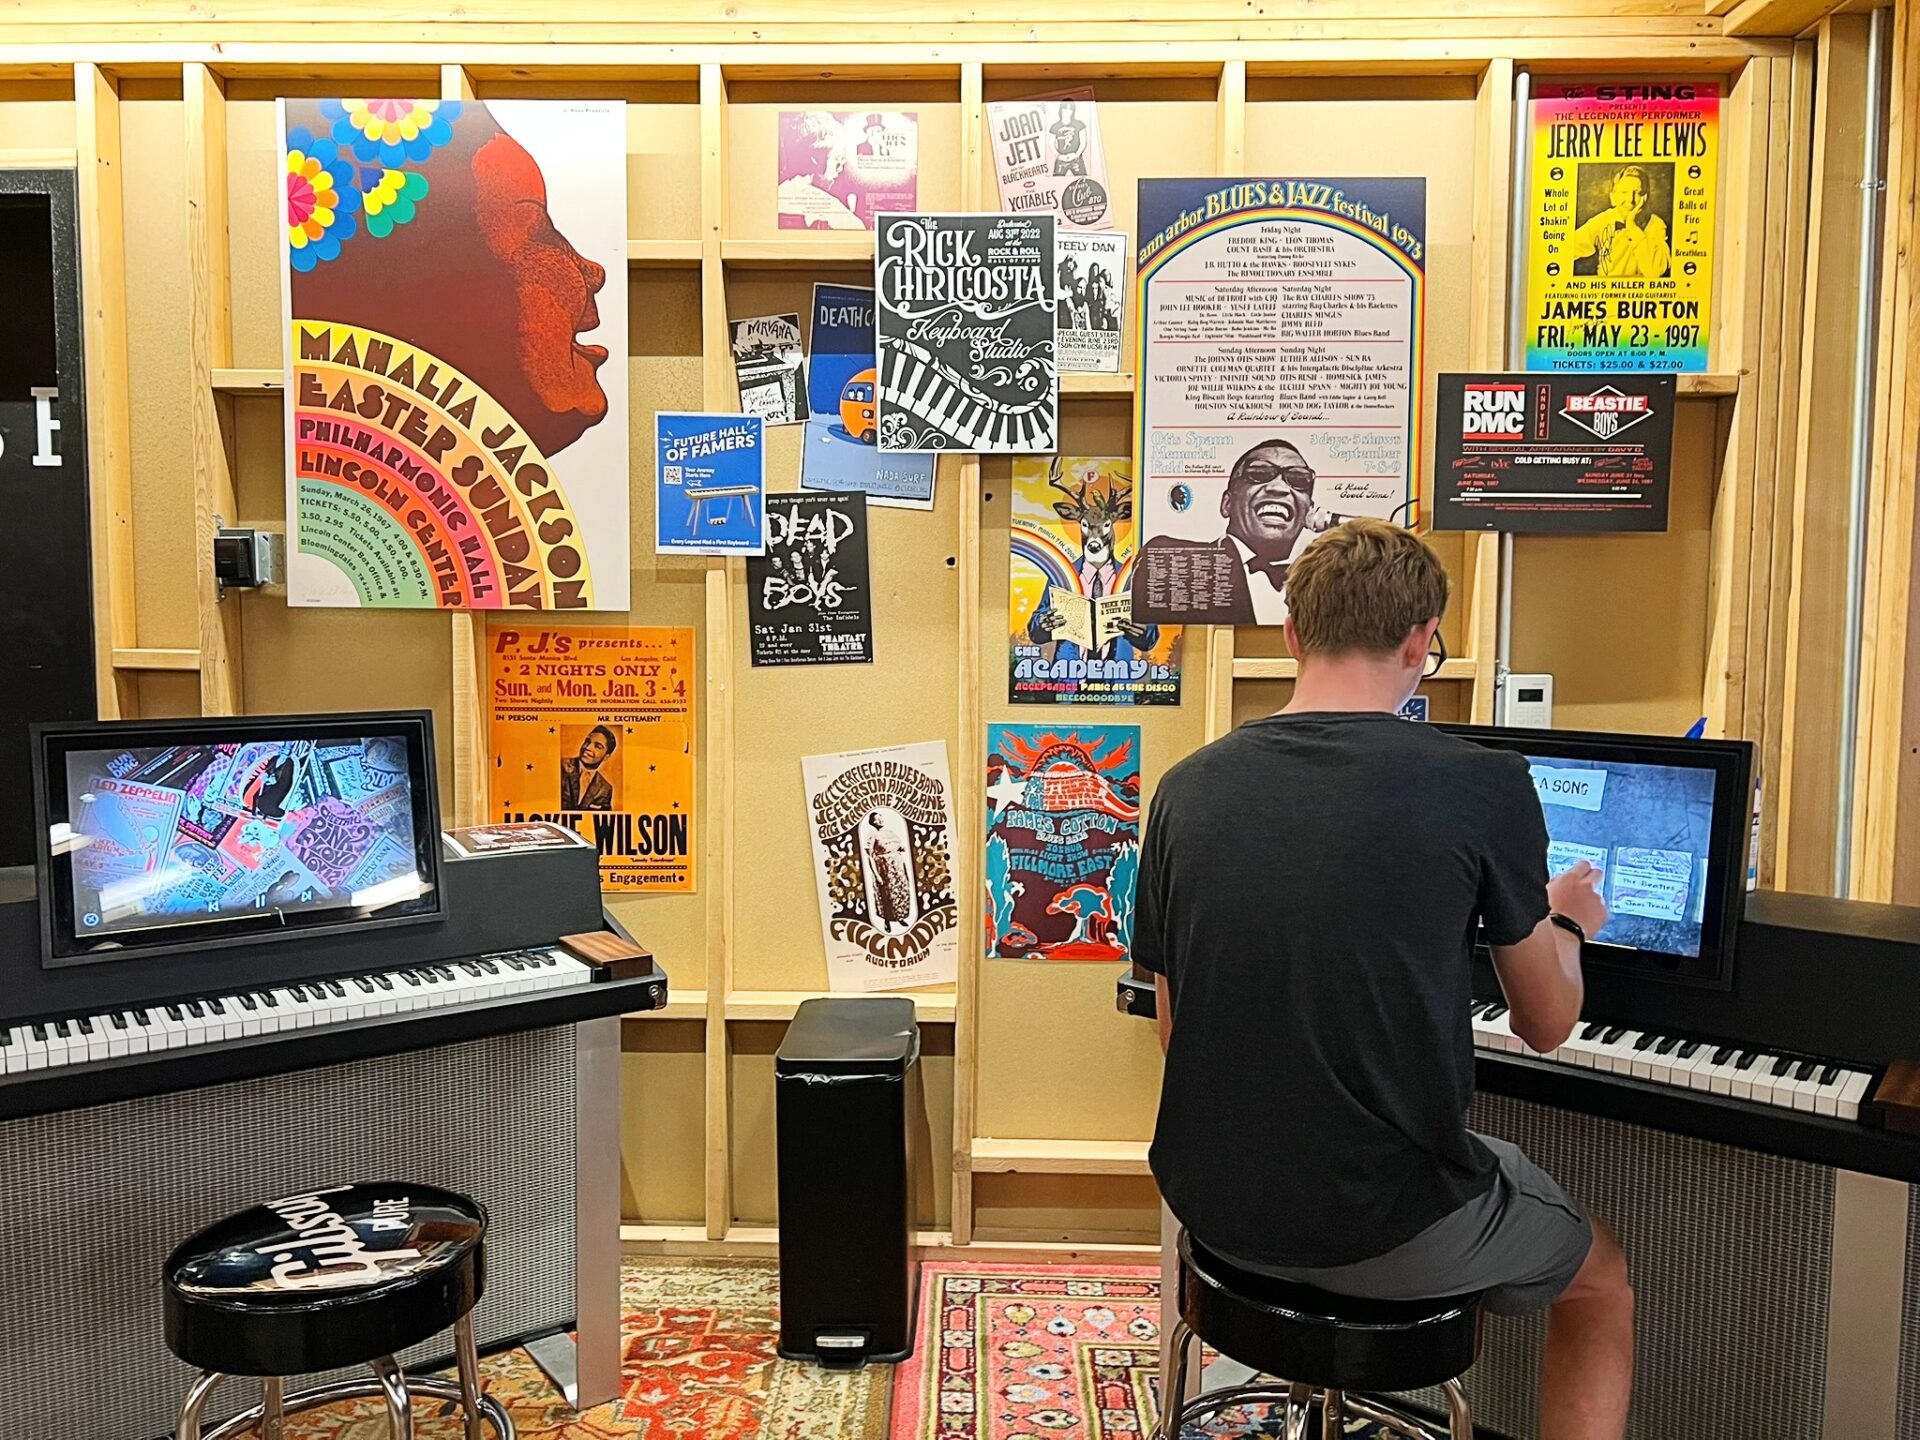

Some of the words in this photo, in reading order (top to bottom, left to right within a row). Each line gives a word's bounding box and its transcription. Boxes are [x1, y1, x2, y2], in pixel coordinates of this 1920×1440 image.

[1597, 86, 1695, 100] STING
[1000, 111, 1043, 141] JOAN
[1555, 112, 1574, 120] THE
[1578, 112, 1636, 120] LEGENDARY
[1548, 124, 1604, 158] JERRY
[1615, 124, 1643, 156] LEE
[1653, 123, 1706, 157] LEWIS
[1006, 136, 1040, 166] JETT
[1002, 164, 1048, 184] BLACKHEARTS
[1009, 190, 1058, 211] YCITABLES
[1545, 189, 1569, 198] Whole
[1684, 187, 1704, 196] Great
[1286, 182, 1332, 207] JAZZ
[1334, 191, 1389, 236] festival
[1544, 203, 1556, 211] Lot
[1560, 202, 1568, 211] of
[1680, 201, 1696, 210] Balls
[1700, 201, 1707, 210] of
[1140, 233, 1163, 263] ann
[1166, 208, 1204, 240] arbor
[1205, 182, 1266, 219] BLUES
[1269, 184, 1285, 203] &
[1540, 216, 1570, 226] Shakin'
[1685, 215, 1699, 224] Fire
[988, 230, 1004, 239] AUG
[1021, 229, 1040, 239] 2022
[1543, 231, 1565, 241] Going
[887, 220, 982, 271] RICK
[1058, 241, 1088, 250] TEELY
[1092, 243, 1115, 252] DAN
[1549, 245, 1558, 253] On
[878, 256, 1049, 309] CHIRICOSTA
[1566, 281, 1586, 289] AND
[1590, 281, 1606, 289] HIS
[1611, 281, 1644, 289] KILLER
[1650, 281, 1676, 289] BAND
[821, 306, 862, 327] DEATH
[1541, 301, 1607, 320] JAMES
[1617, 301, 1698, 319] BURTON
[748, 320, 793, 340] NIRVANA
[907, 310, 1011, 347] Keyboard
[1537, 327, 1575, 350] FRI.,
[1584, 326, 1621, 348] MAY
[1631, 326, 1648, 347] 23
[1666, 326, 1699, 347] 1997
[970, 338, 1039, 362] Studio
[1553, 361, 1596, 369] TICKETS:
[1601, 361, 1634, 369] $25.00
[1650, 360, 1683, 369] $27.00
[1464, 391, 1525, 412] RUN
[1569, 396, 1644, 411] BEASTIE
[1464, 412, 1524, 433] DMC
[1594, 412, 1619, 435] BOYS
[674, 431, 717, 448] FUTURE
[719, 425, 747, 438] HALL
[666, 448, 688, 462] OF
[692, 435, 755, 458] FAMERS
[1152, 446, 1216, 459] Memorial
[1330, 446, 1401, 462] September
[301, 326, 477, 429] MAHALIA
[481, 423, 587, 609] JACKSON
[300, 373, 457, 464] EASTER
[452, 456, 542, 609] SUNDAY
[300, 498, 340, 512] TICKETS:
[300, 419, 467, 532] PHILHARMONIC
[459, 536, 492, 599] HALL
[301, 486, 332, 498] Sunday,
[335, 492, 359, 506] March
[373, 513, 391, 529] 1967
[302, 452, 408, 512] LINCOLN
[407, 510, 461, 606] CENTER
[766, 504, 854, 554] DEAD
[301, 539, 356, 571] Bloomingdales
[302, 526, 330, 537] Lincoln
[333, 534, 357, 552] Center
[357, 552, 369, 566] Box
[369, 566, 383, 590] Office
[350, 528, 374, 550] Tickets
[374, 551, 395, 584] Available
[763, 568, 857, 611] BOYS
[755, 625, 775, 634] Sat
[781, 624, 802, 633] Jan
[809, 623, 832, 632] 31st
[819, 634, 866, 643] PHANTASY
[496, 632, 520, 653] P.
[821, 642, 863, 651] THEATRE
[520, 665, 530, 675] 2
[536, 665, 606, 676] NIGHTS
[614, 666, 660, 676] ONLY
[1014, 659, 1148, 679] ACADEMY
[495, 679, 532, 697] Sun.
[537, 683, 552, 693] and
[557, 680, 596, 697] Mon.
[603, 680, 639, 697] Jan.
[646, 680, 656, 697] 3
[673, 680, 686, 697] 4
[1015, 682, 1079, 691] ACCEPTANCE
[1080, 680, 1111, 692] PANIC
[1112, 683, 1124, 692] AT
[1146, 684, 1176, 692] DISCO
[1056, 694, 1134, 702] HELLOGOODBYE
[121, 783, 177, 803] ZEPPELIN
[813, 762, 883, 810] BUTTERFIELD
[884, 762, 919, 784] BLUES
[919, 774, 944, 794] BAND
[1552, 780, 1588, 796] SONG
[815, 778, 886, 824] JEFFERSON
[888, 780, 946, 810] AIRPLANE
[320, 805, 361, 825] CHEETAH
[818, 823, 838, 839] BIG
[870, 794, 893, 807] MAE
[894, 795, 947, 823] THORNTON
[1006, 810, 1054, 834] JAMES
[1060, 813, 1119, 835] COTTON
[594, 814, 687, 855] WILSON
[1011, 856, 1076, 878] FILLMORE
[1077, 856, 1113, 876] EAST
[610, 873, 676, 885] Engagement
[1623, 878, 1636, 887] The
[1648, 901, 1670, 911] Track
[830, 905, 957, 959] FILLMORE
[866, 948, 930, 968] AUDITORIUM
[372, 1196, 413, 1232] PURE
